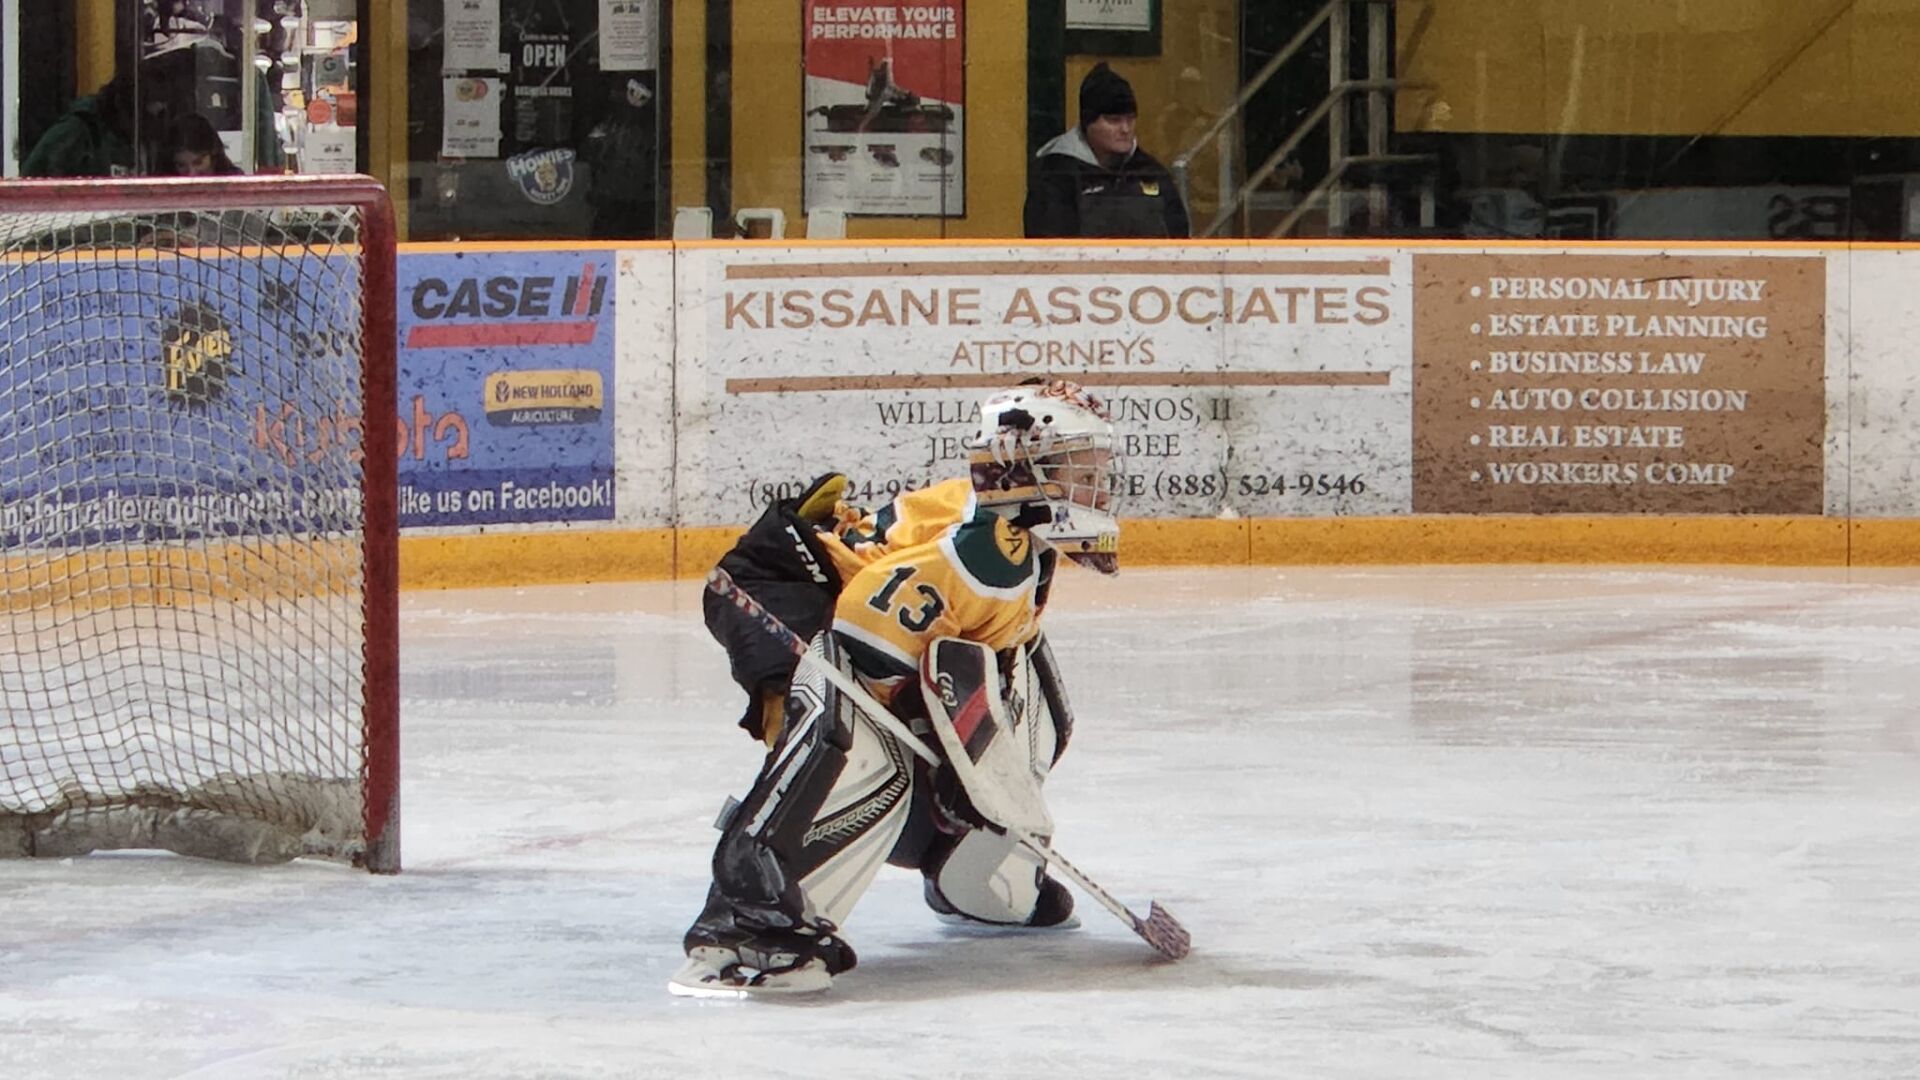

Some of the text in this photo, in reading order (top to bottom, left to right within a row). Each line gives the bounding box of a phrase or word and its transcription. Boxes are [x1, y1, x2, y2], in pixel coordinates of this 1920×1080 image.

[813, 7, 955, 22] ELEVATE YOUR
[812, 24, 956, 39] PERFORMANCE
[523, 44, 566, 67] OPEN
[412, 276, 555, 320] CASE
[1489, 278, 1767, 307] PERSONAL INJURY
[725, 286, 1390, 329] KISSANE ASSOCIATES
[1489, 315, 1768, 338] ESTATE PLANNING
[950, 336, 1155, 368] ATTORNEYS
[1489, 351, 1706, 374] BUSINESS LAW
[513, 384, 593, 399] NEW HOLLAND
[1488, 388, 1748, 412] AUTO COLLISION
[876, 400, 983, 426] WILLIA
[1104, 396, 1200, 427] UNOS,
[1124, 434, 1181, 457] BEE
[1489, 426, 1684, 447] REAL ESTATE
[1155, 470, 1229, 501] (888)
[1239, 472, 1366, 497] 524-9546
[1488, 463, 1735, 485] WORKERS COMP
[401, 479, 611, 514] ike us on Facebook!
[867, 566, 945, 632] 13
